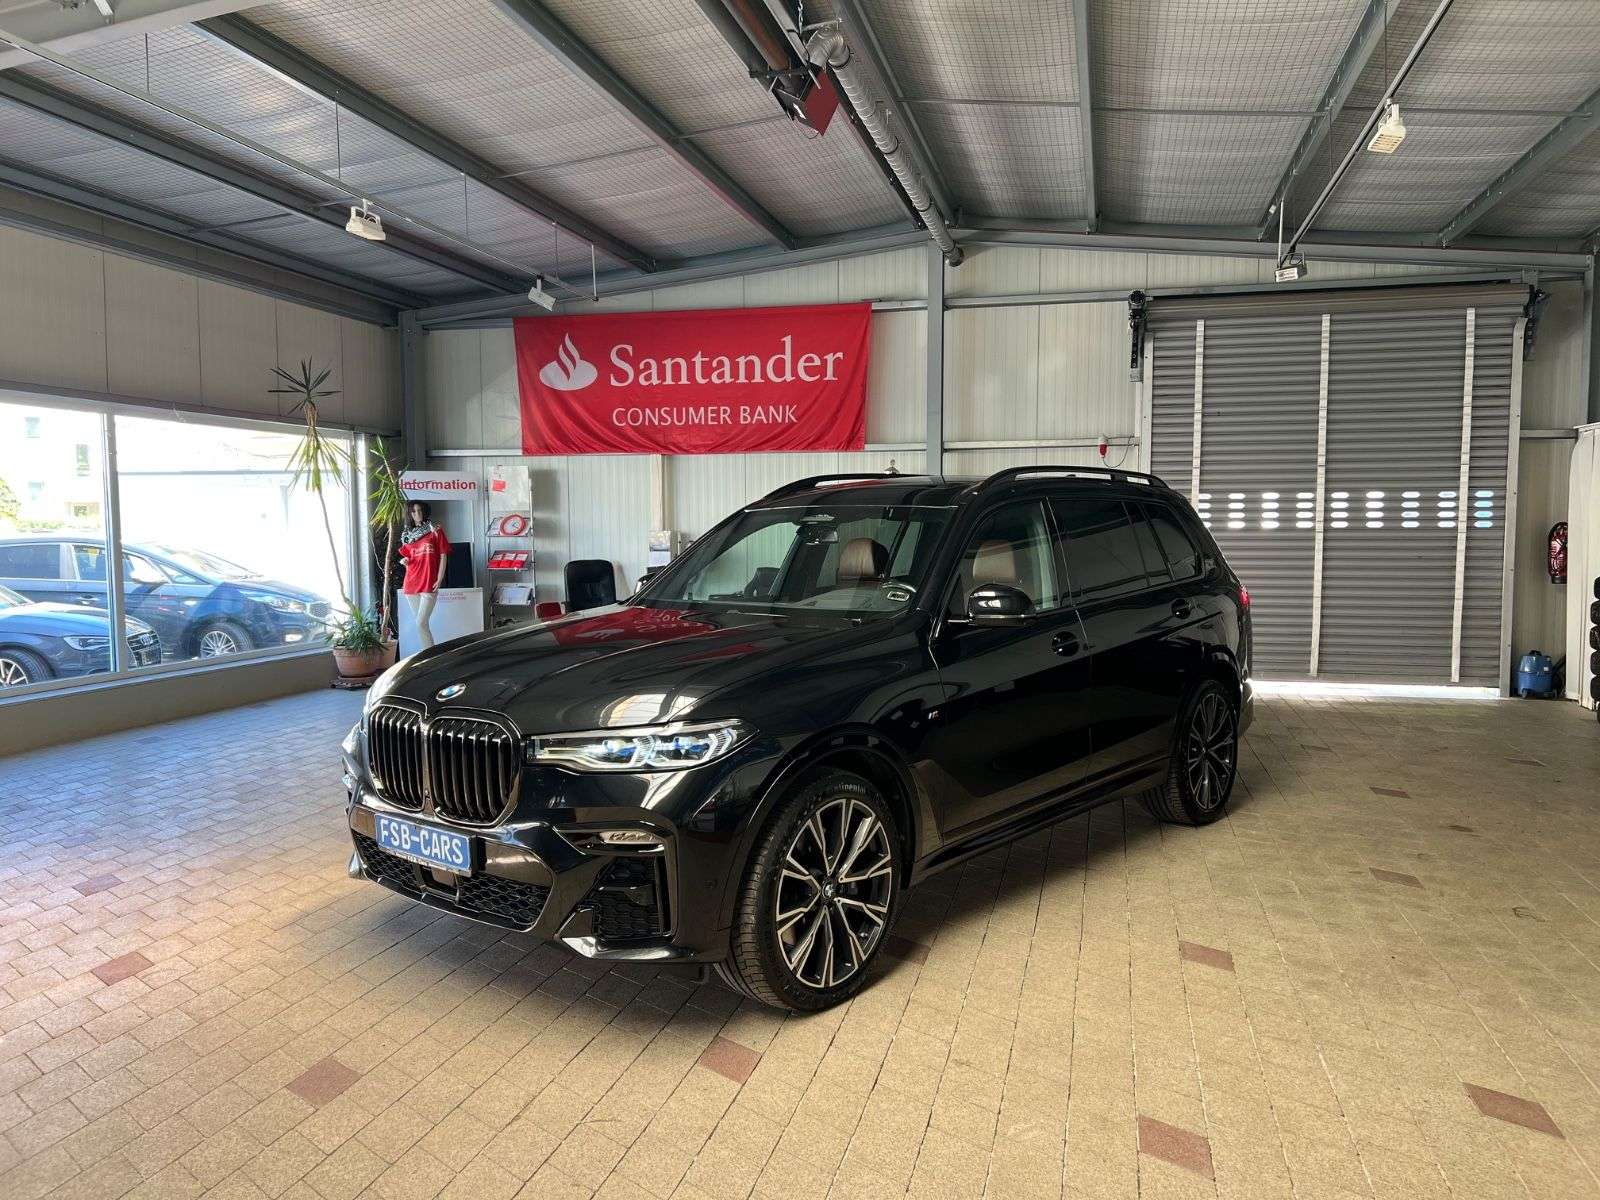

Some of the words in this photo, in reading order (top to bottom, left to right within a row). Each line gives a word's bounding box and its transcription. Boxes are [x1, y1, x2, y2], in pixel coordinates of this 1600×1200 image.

[609, 334, 844, 387] Santander
[612, 406, 733, 426] CONSUMER
[740, 405, 798, 425] BANK
[400, 479, 476, 490] Information
[380, 818, 463, 864] FSB-CARS
